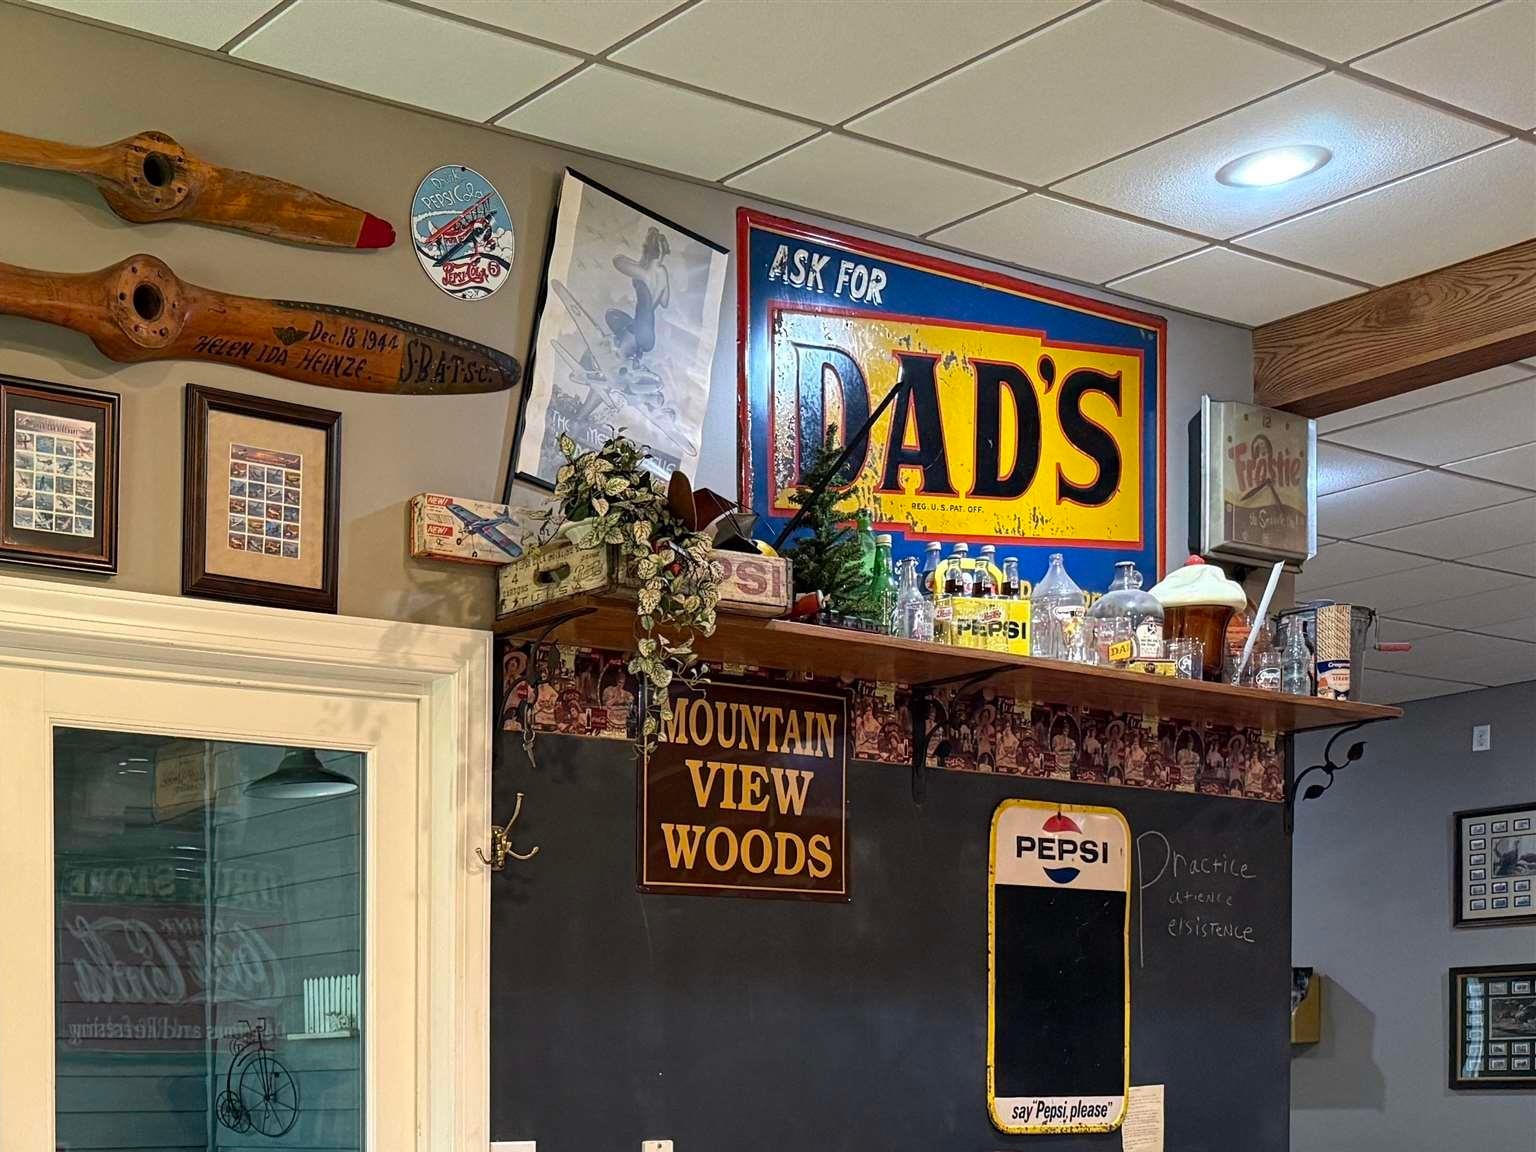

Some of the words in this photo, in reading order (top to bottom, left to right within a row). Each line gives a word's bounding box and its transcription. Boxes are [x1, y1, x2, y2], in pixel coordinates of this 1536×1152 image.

[768, 244, 830, 293] ASK
[834, 260, 888, 305] FOR
[194, 335, 256, 360] HELEN
[256, 344, 289, 367] IDA
[790, 342, 1124, 508] DAD'S
[427, 495, 449, 506] NEW!
[911, 501, 927, 512] REG.
[427, 525, 449, 536] NEW!
[957, 618, 1027, 641] PEPSI
[659, 697, 838, 759] MOUNTAIN
[685, 759, 815, 817] VIEW
[661, 823, 834, 879] WOODS
[1016, 835, 1109, 864] PEPSI
[1011, 1103, 1032, 1123] say
